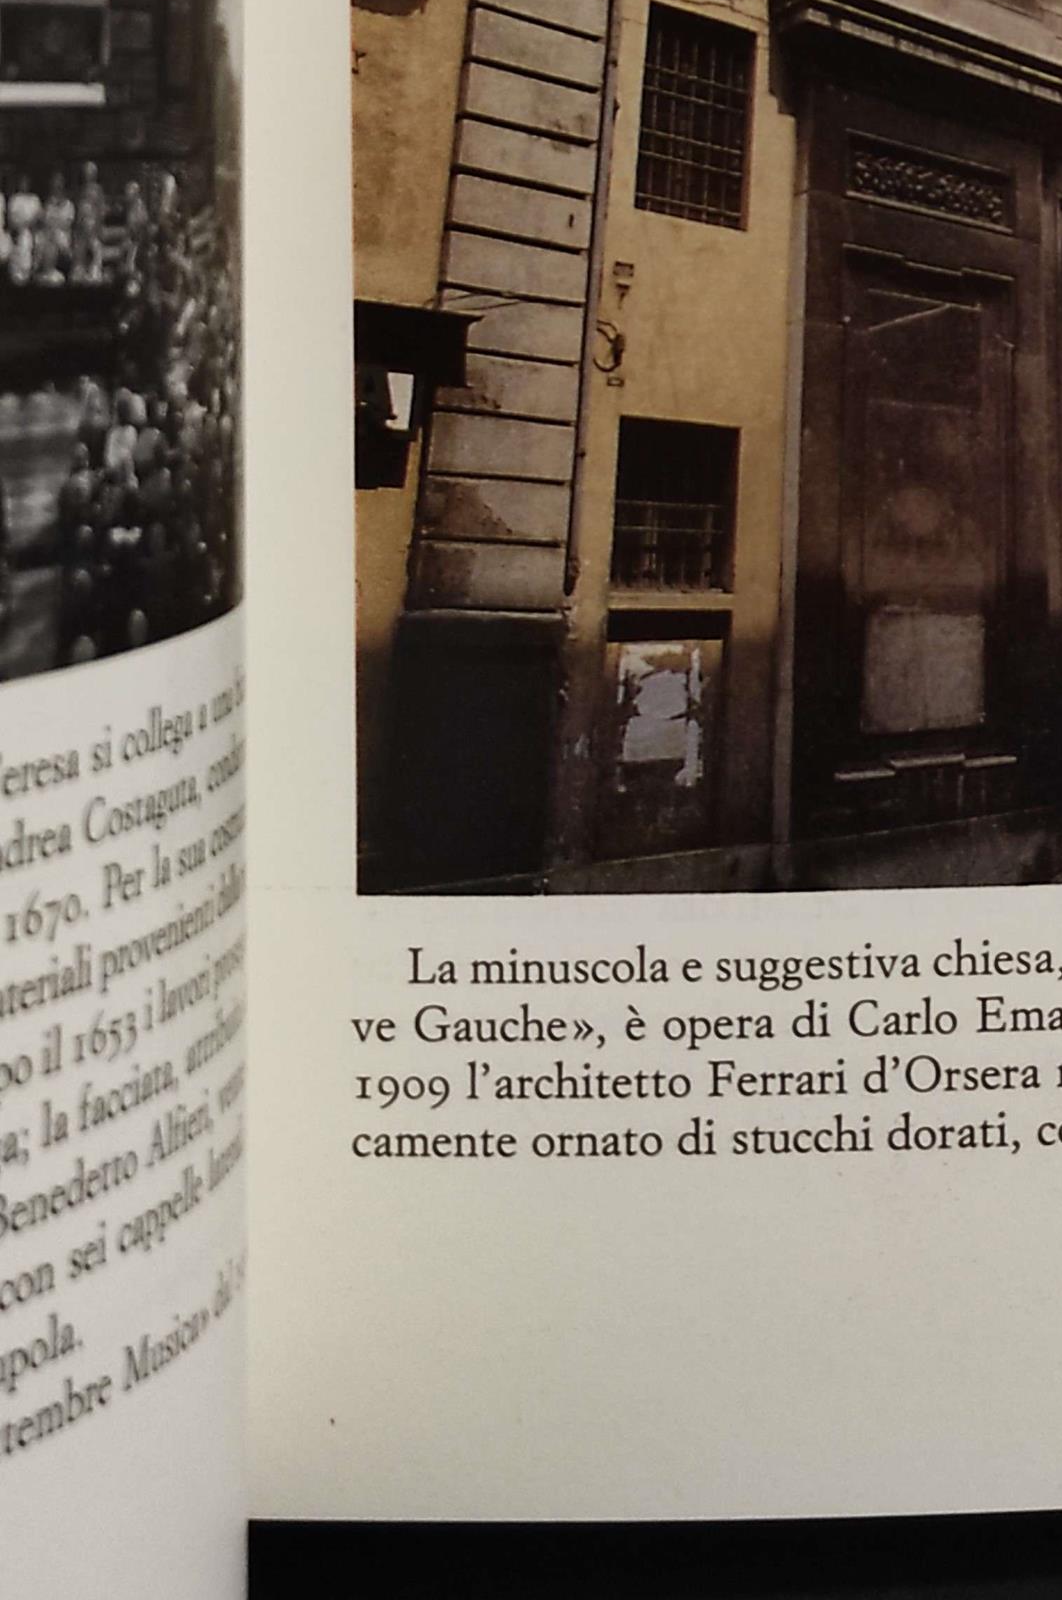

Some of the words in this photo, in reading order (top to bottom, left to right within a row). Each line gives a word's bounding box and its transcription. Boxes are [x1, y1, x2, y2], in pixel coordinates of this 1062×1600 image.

[0, 746, 80, 797] eresa
[91, 724, 113, 773] si
[122, 705, 194, 756] collega
[4, 888, 90, 943] 1670.
[102, 862, 145, 910] Per
[151, 844, 172, 888] la
[407, 946, 459, 985] La
[469, 943, 670, 985] minuscola
[681, 958, 703, 983] e
[715, 942, 922, 992] suggestiva
[42, 1024, 63, 1075] il
[73, 1009, 139, 1064] 1653
[350, 1018, 397, 1043] ve
[413, 1002, 606, 1050] Gauche»,
[624, 1004, 647, 1042] è
[662, 1014, 776, 1051] opera
[791, 998, 832, 1039] di
[848, 995, 958, 1038] Carlo
[41, 1099, 70, 1148] la
[80, 1061, 180, 1133] facciata,
[355, 1075, 451, 1110] 1909
[466, 1059, 692, 1101] l’architetto
[707, 1057, 849, 1098] Ferrari
[862, 1054, 1042, 1095] d’Orsera
[351, 1129, 518, 1159] camente
[531, 1127, 664, 1159] ornato
[676, 1116, 718, 1157] di
[732, 1113, 875, 1156] stucchi
[886, 1110, 1021, 1155] dorati,
[0, 1261, 56, 1311] con
[69, 1219, 108, 1280] sei
